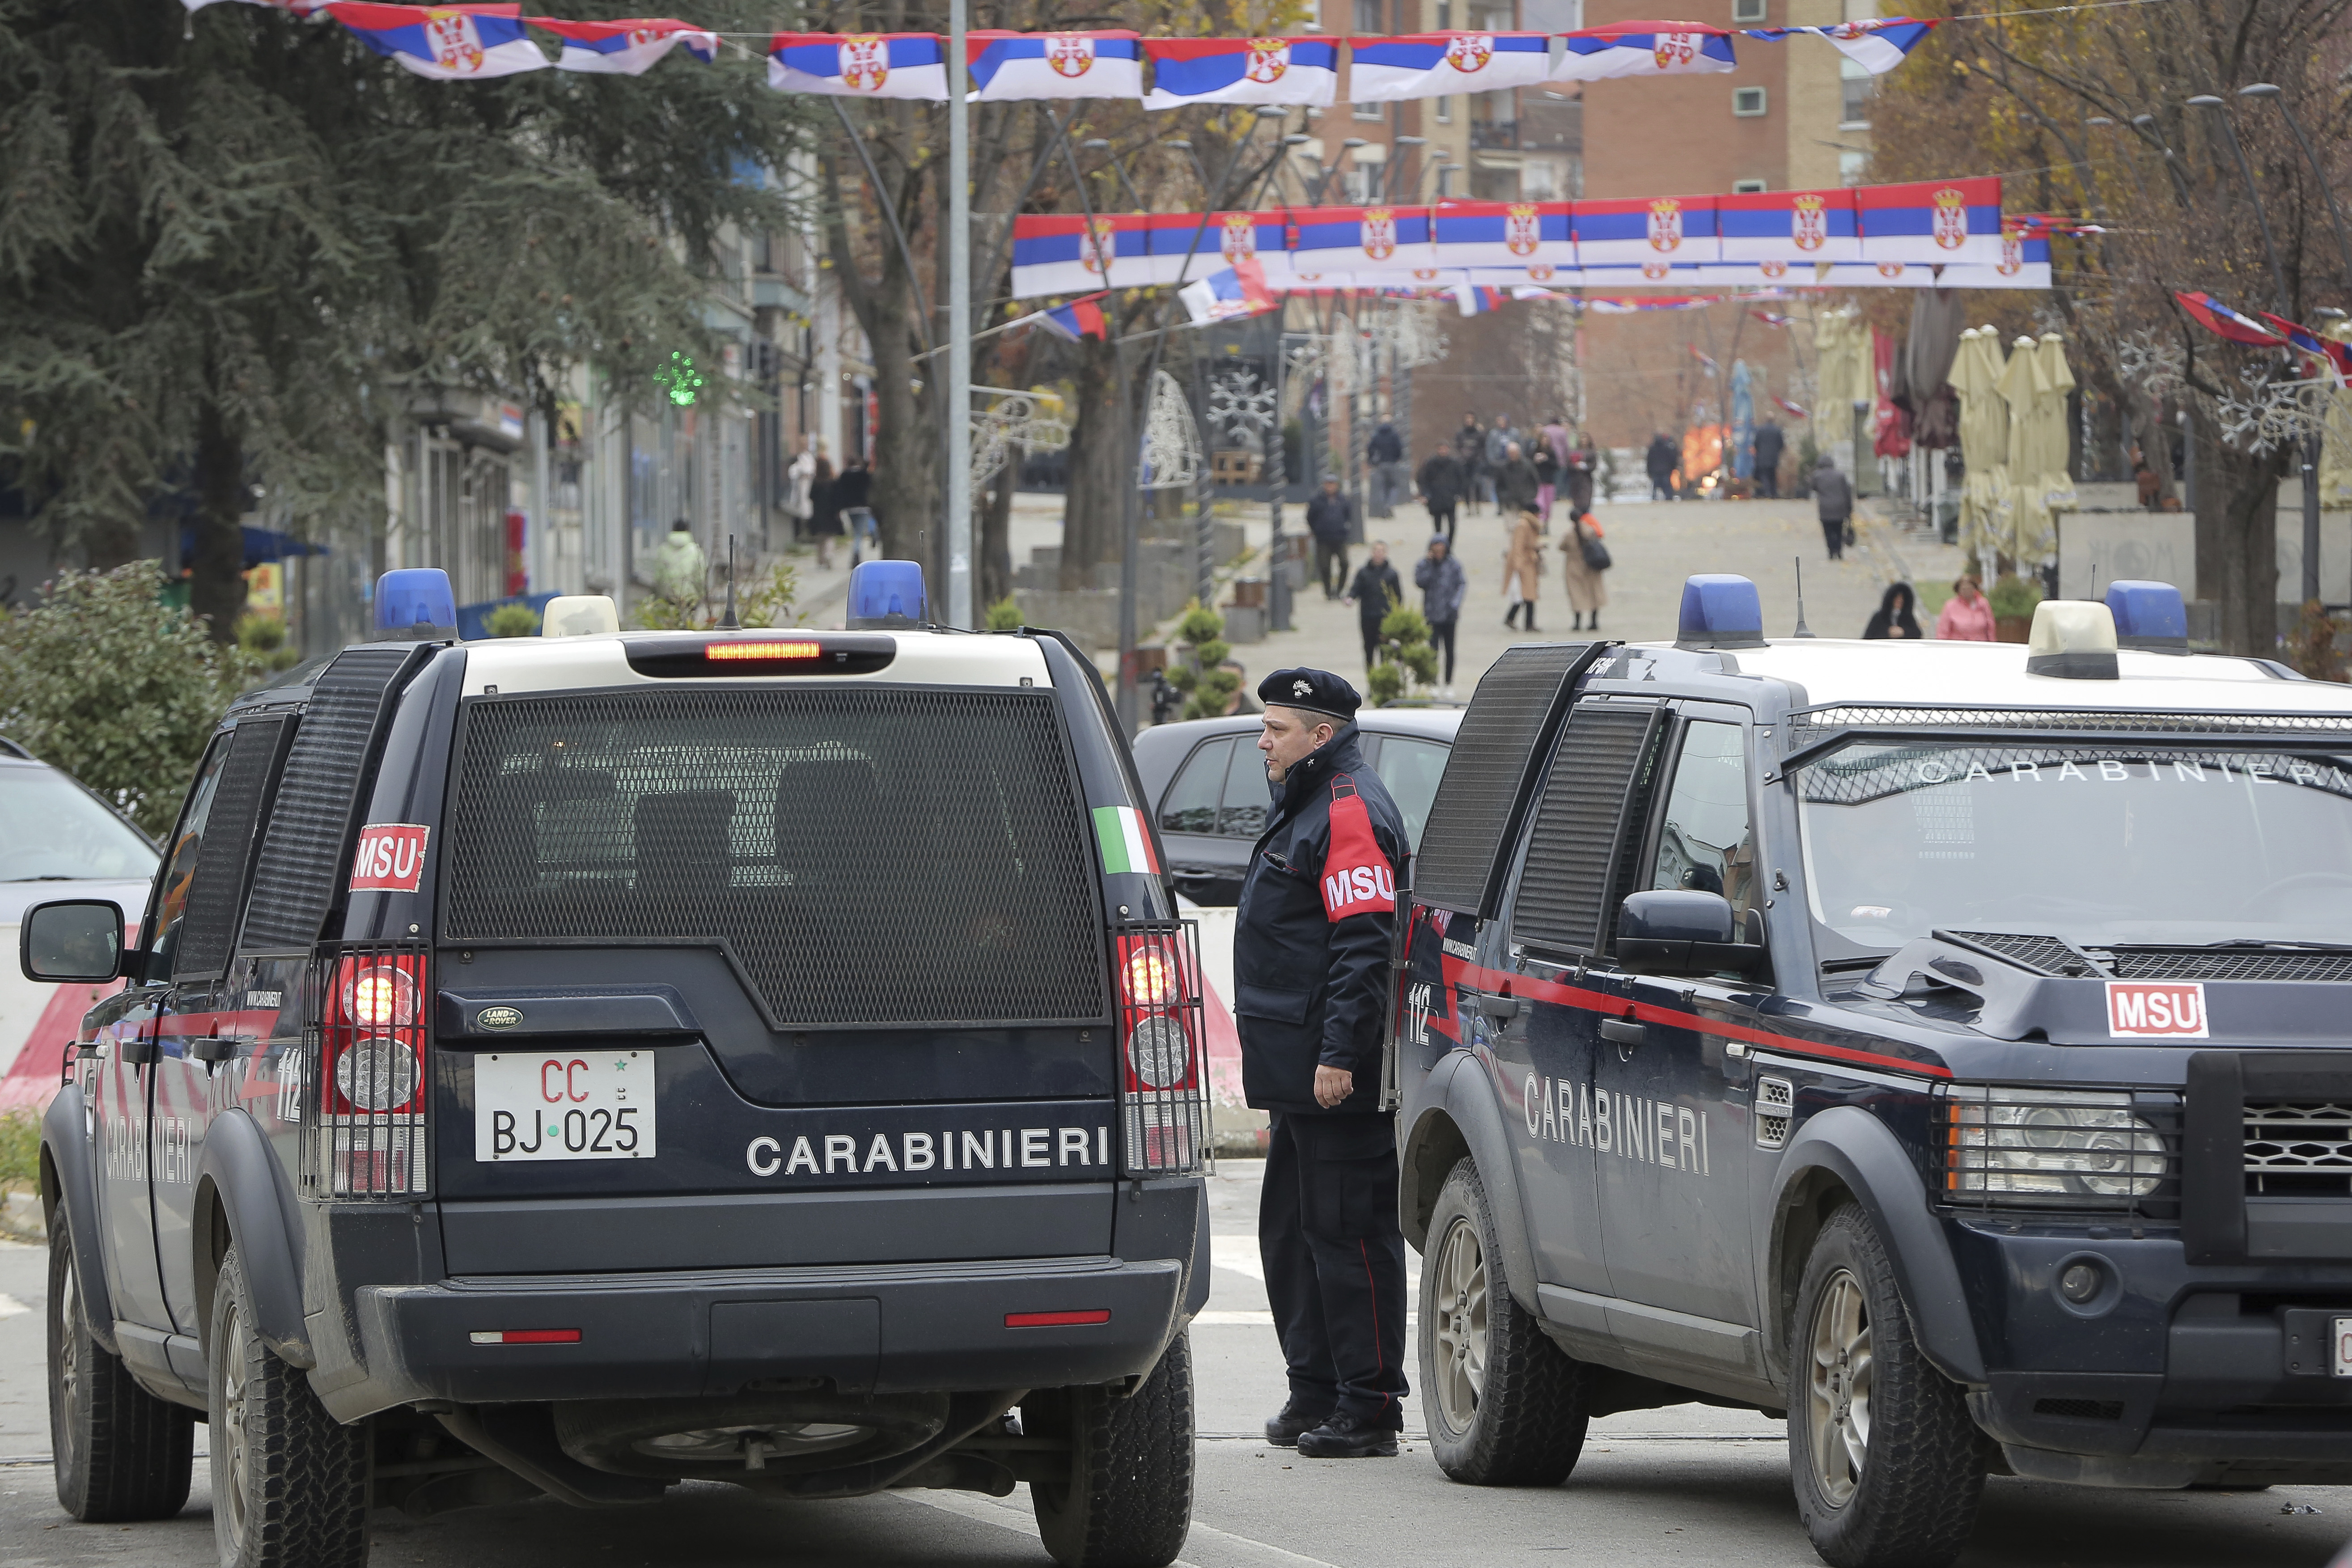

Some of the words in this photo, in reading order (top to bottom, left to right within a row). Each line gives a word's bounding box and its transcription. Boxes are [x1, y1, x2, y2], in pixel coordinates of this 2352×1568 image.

[1919, 760, 2349, 787] CARABINIERI
[354, 836, 417, 879] MSU
[1326, 865, 1395, 912] MSU
[1408, 983, 1431, 1046] 112
[2116, 992, 2198, 1029] MSU
[276, 1047, 310, 1123] 112
[541, 1059, 589, 1102] CC
[1524, 1072, 1710, 1176] CARABINIERI
[106, 1116, 191, 1184] CARABINIERI
[746, 1126, 1108, 1177] CARABINIERI
